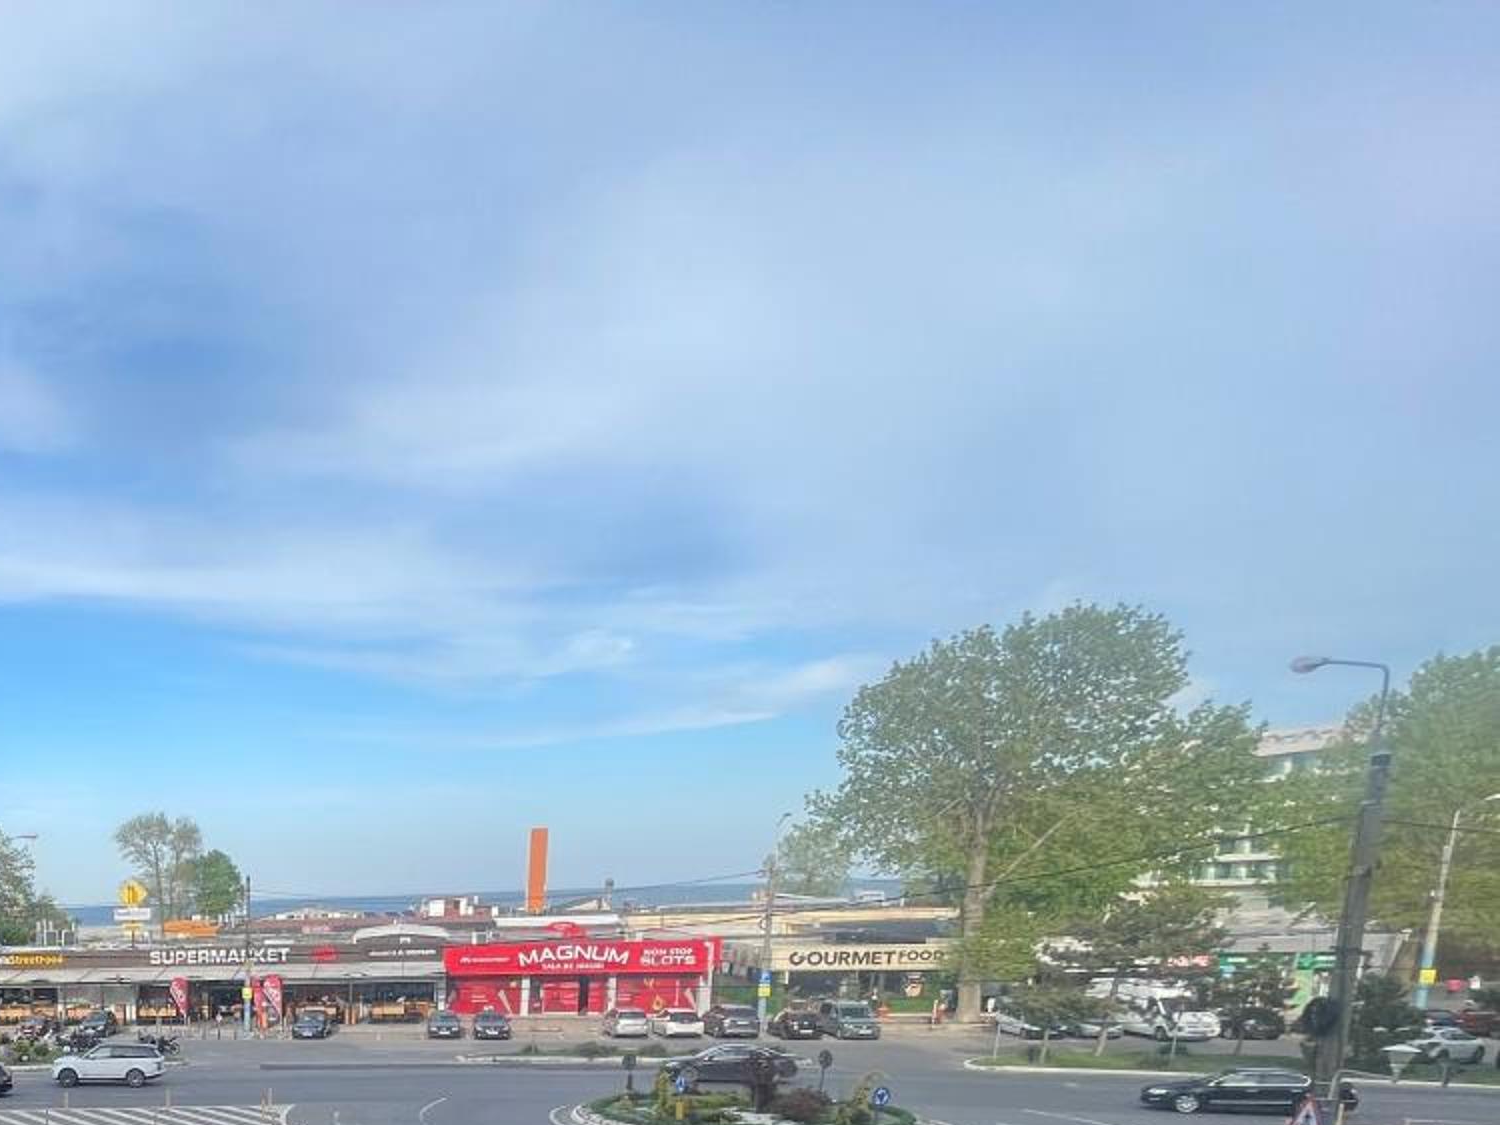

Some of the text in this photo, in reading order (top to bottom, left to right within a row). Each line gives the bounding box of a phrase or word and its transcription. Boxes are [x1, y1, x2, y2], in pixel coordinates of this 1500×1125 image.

[517, 945, 630, 967] MAGNUM
[640, 955, 697, 966] SLOTS
[789, 949, 945, 966] GOURMET FOOD
